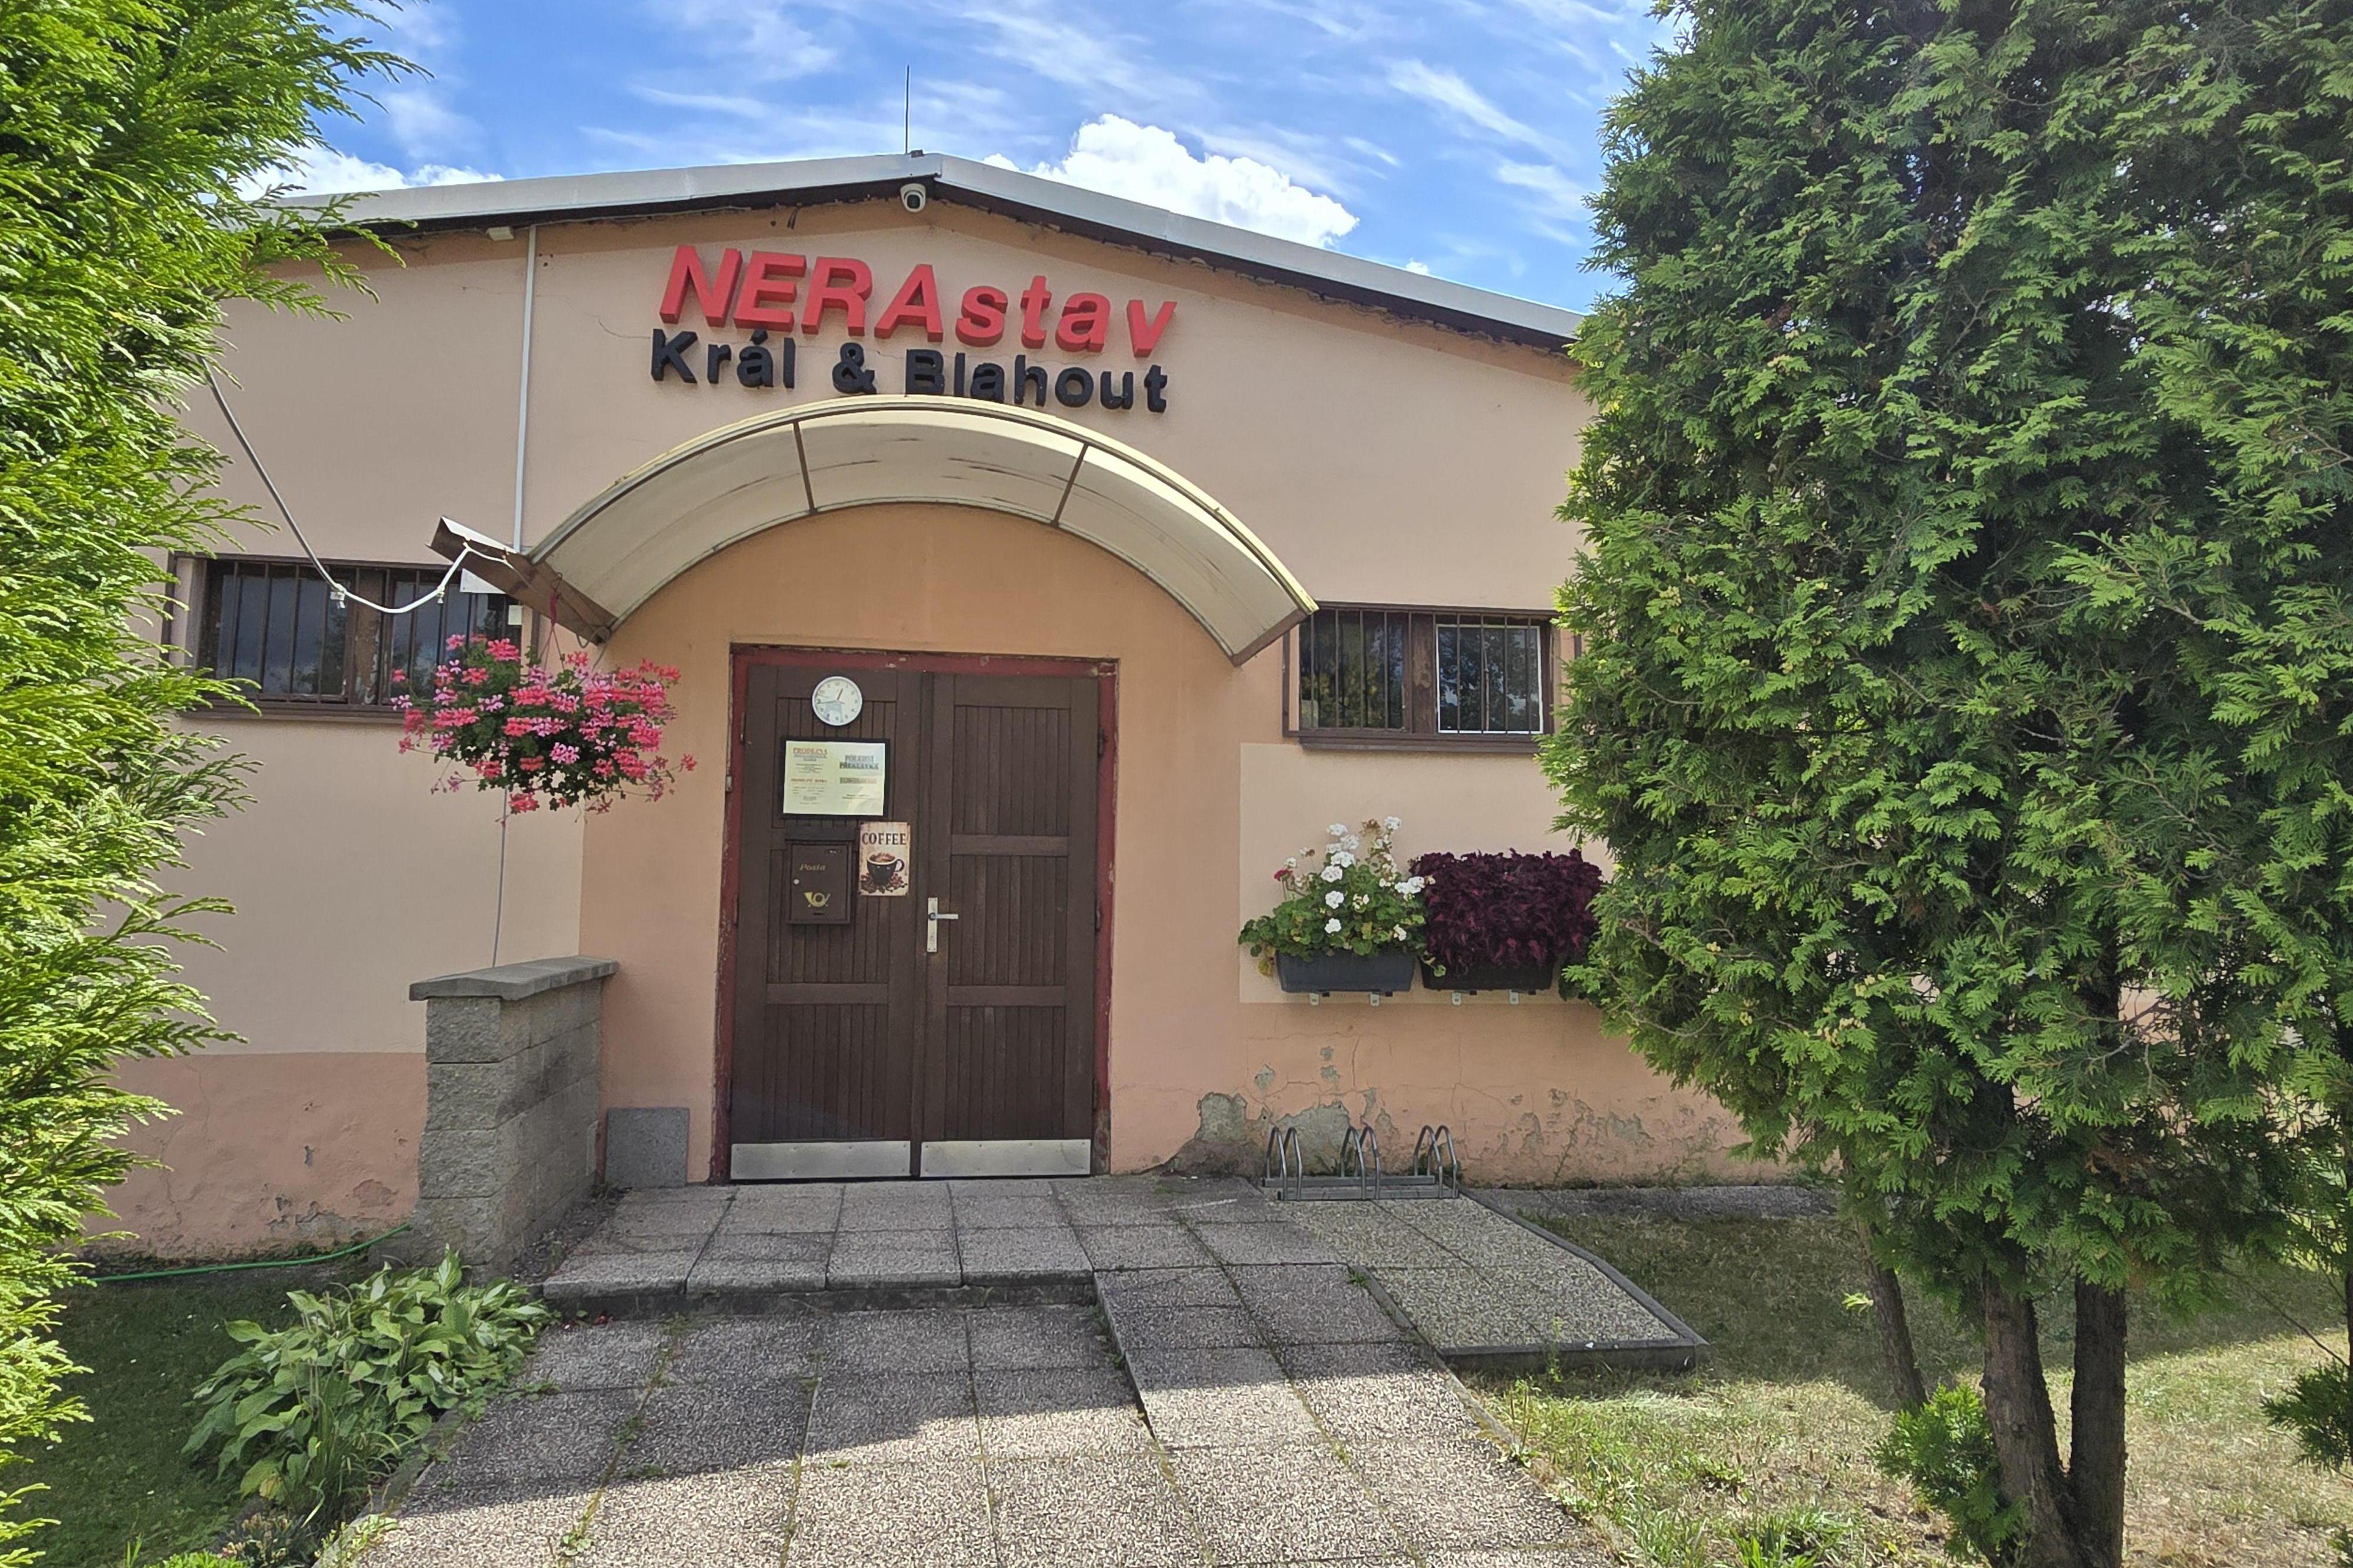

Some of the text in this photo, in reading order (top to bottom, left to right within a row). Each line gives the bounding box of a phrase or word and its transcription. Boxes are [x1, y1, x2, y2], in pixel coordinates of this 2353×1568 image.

[659, 244, 1177, 358] NERAstav
[651, 328, 1169, 413] Král & Blahout
[862, 832, 906, 845] COFFEE
